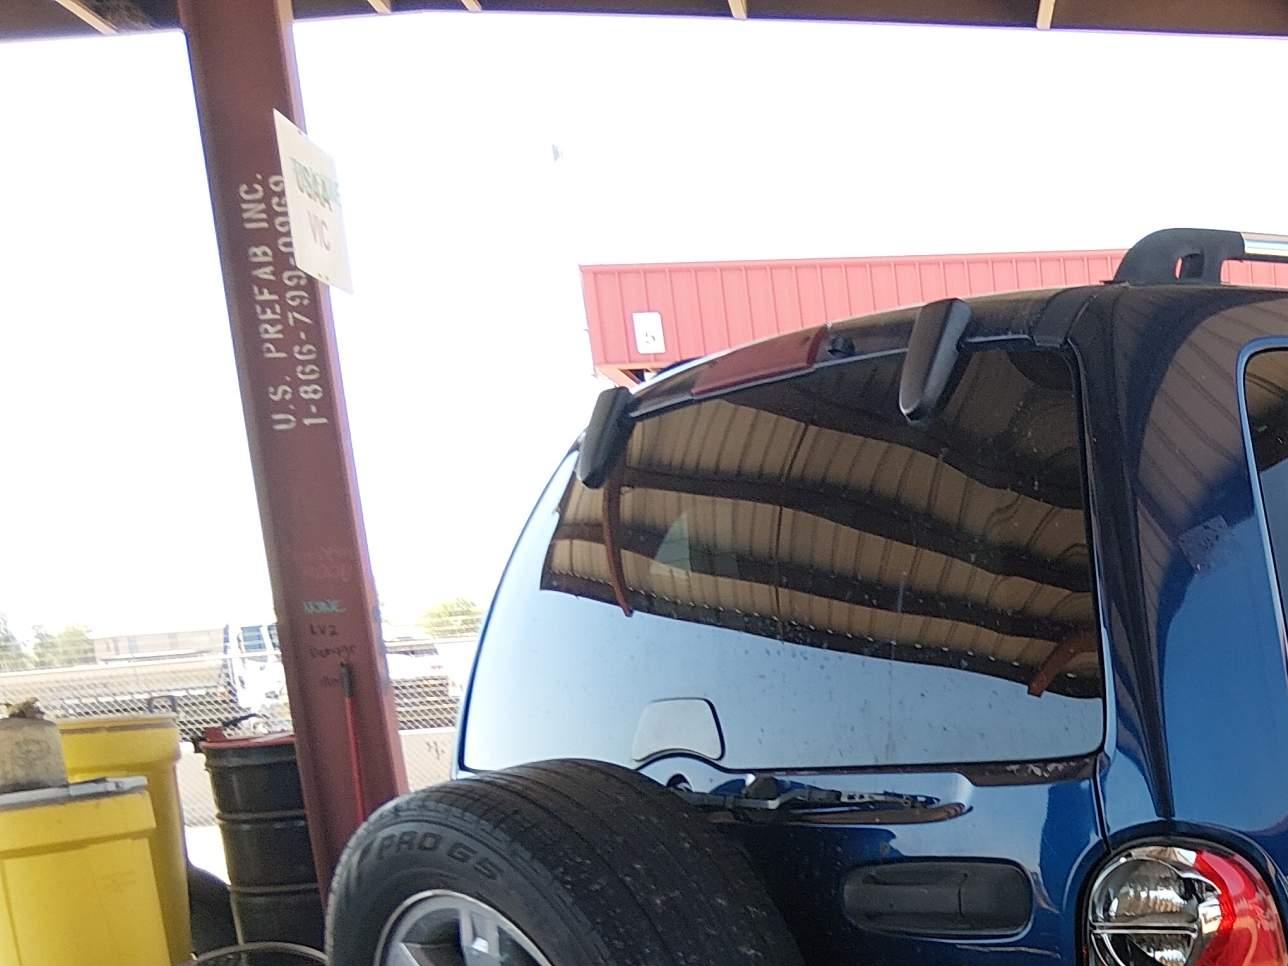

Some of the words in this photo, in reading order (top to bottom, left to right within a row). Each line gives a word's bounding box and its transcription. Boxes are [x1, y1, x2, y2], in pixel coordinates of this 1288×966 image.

[239, 173, 269, 231] INC.
[247, 245, 288, 360] PREFAB
[269, 376, 297, 431] U.S.
